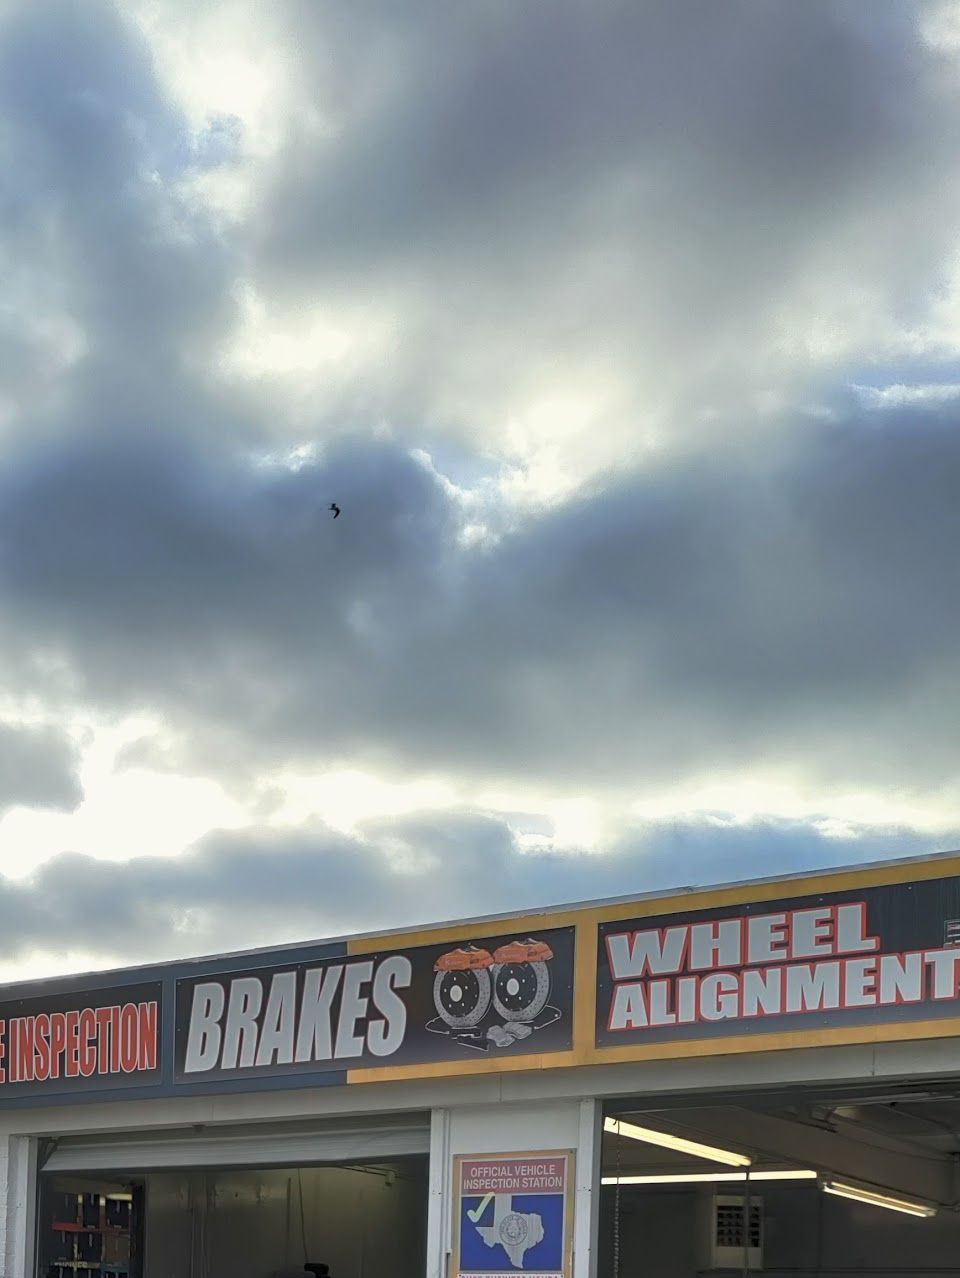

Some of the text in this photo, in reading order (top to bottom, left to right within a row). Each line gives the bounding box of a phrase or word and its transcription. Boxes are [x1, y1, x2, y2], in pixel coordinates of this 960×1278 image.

[605, 902, 880, 980] WHEEL
[184, 955, 413, 1074] BRAKES
[606, 949, 960, 1032] ALIGNMENT
[8, 1002, 158, 1083] INSPECTION
[463, 1176, 563, 1190] INSPECTION STATION
[470, 1164, 556, 1178] OFFICIAL VEHICLE
